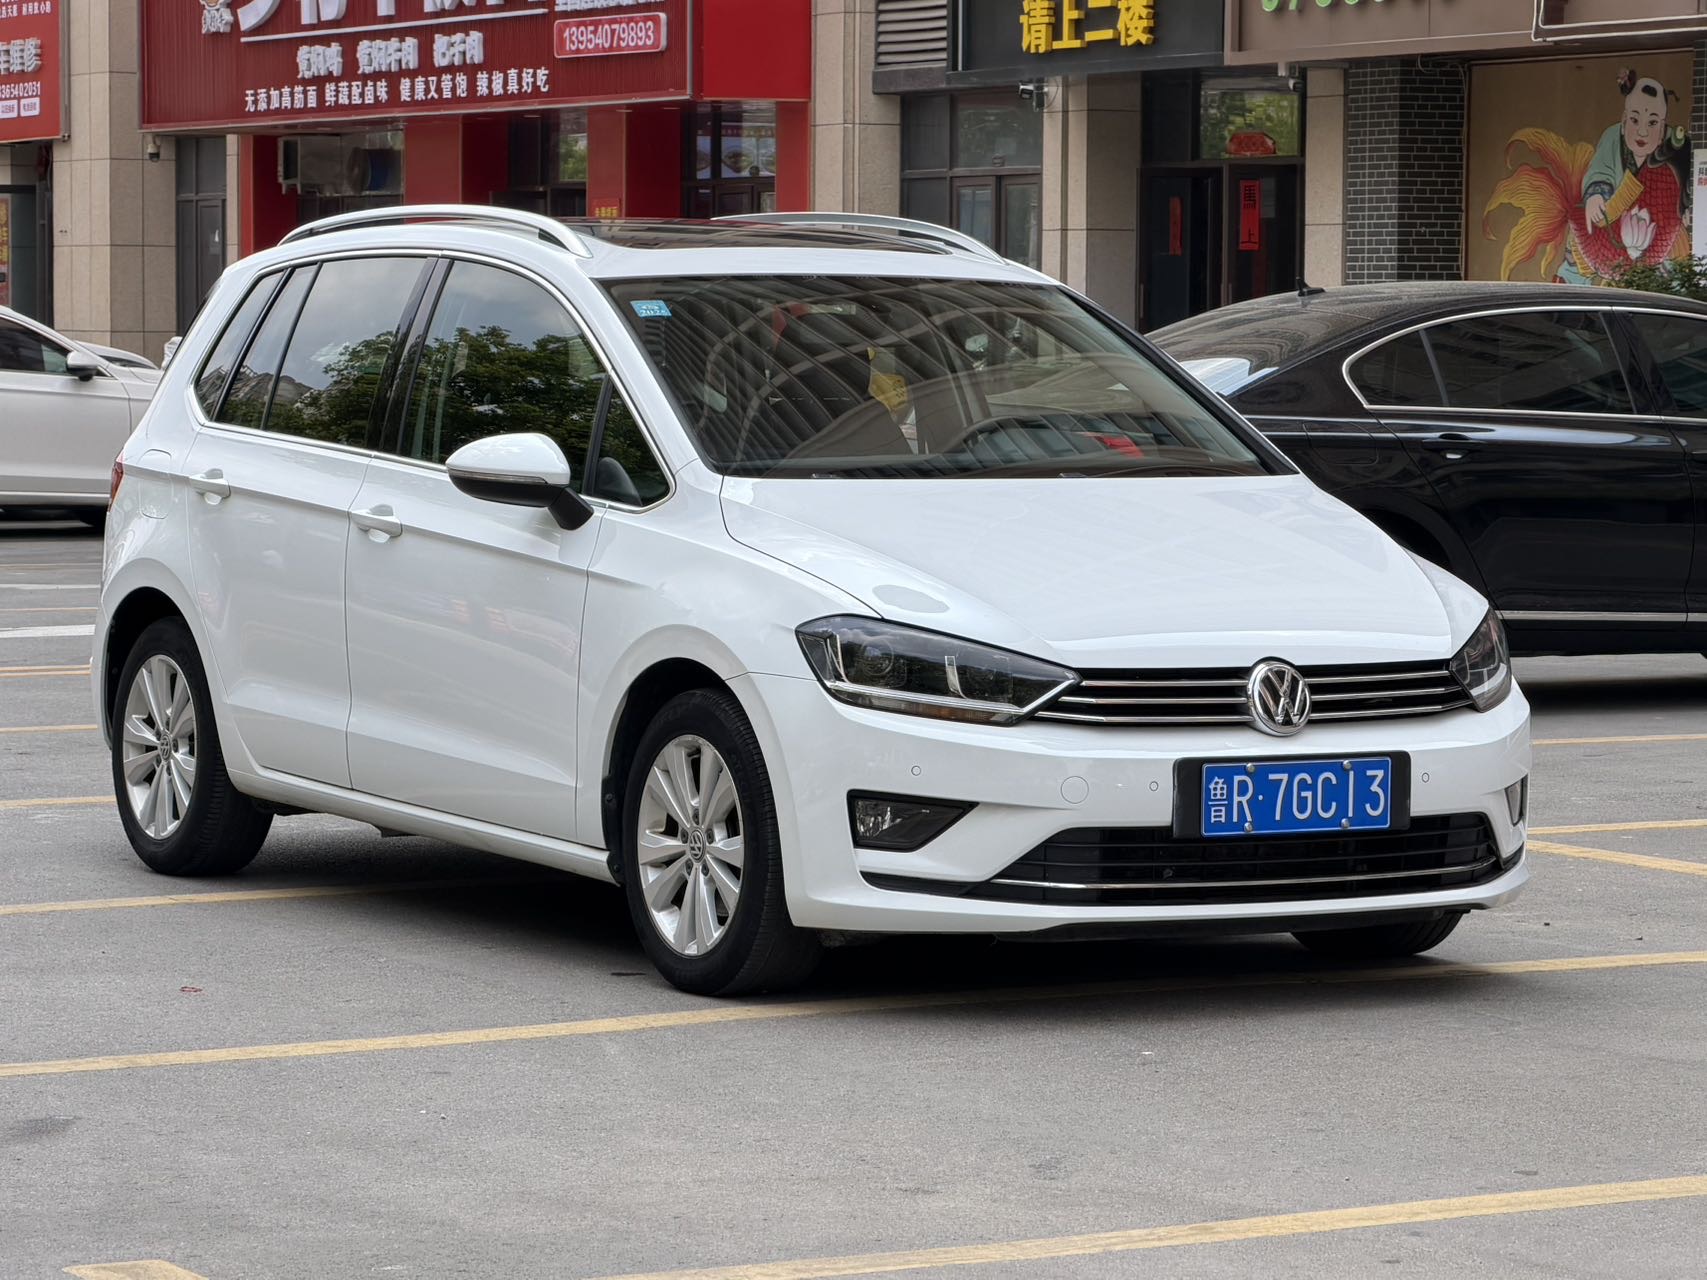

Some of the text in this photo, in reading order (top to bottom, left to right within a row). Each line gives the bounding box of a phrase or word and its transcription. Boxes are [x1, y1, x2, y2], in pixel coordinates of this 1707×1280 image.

[563, 21, 655, 51] 13954079893
[1020, 0, 1154, 54] 请上二楼
[245, 66, 549, 112] 无添加高筋面 鲜蔬配卤味 健康又管饱 辣椒真好吃
